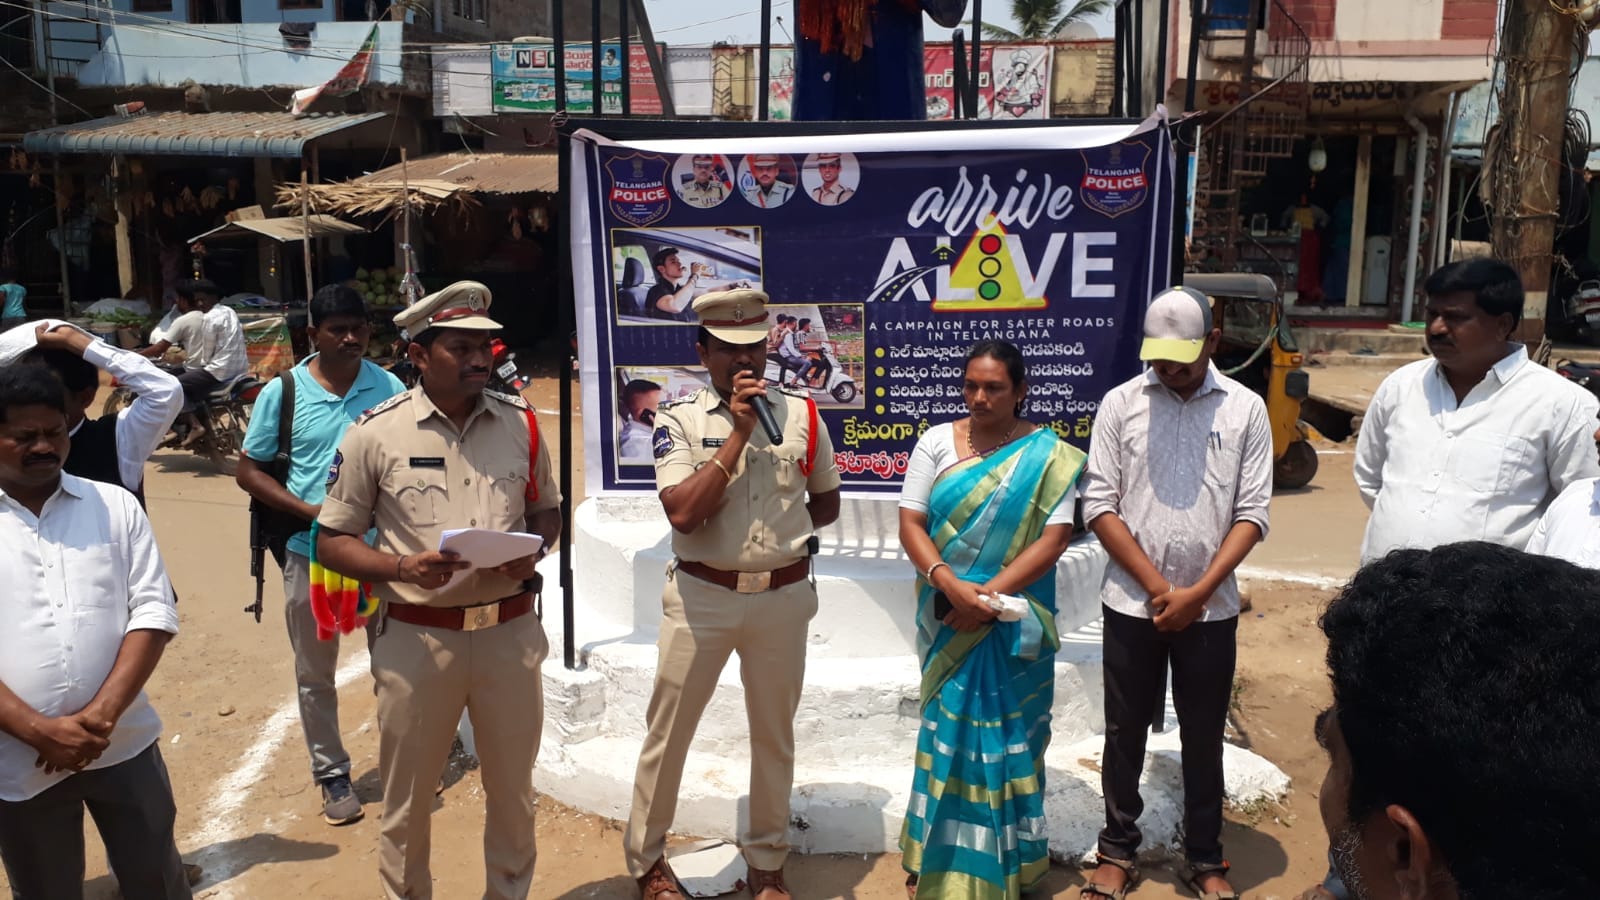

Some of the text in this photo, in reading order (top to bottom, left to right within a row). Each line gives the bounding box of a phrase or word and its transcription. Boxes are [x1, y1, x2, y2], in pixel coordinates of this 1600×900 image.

[1089, 167, 1141, 176] TELANGANA
[616, 181, 662, 189] TELANGANA
[1085, 176, 1144, 189] POLICE
[613, 188, 666, 201] POLICE
[907, 166, 1074, 236] arrive
[869, 317, 1114, 331] A CAMPAIGN FOR SAFER ROADS
[928, 329, 1050, 341] IN TELANGANA
